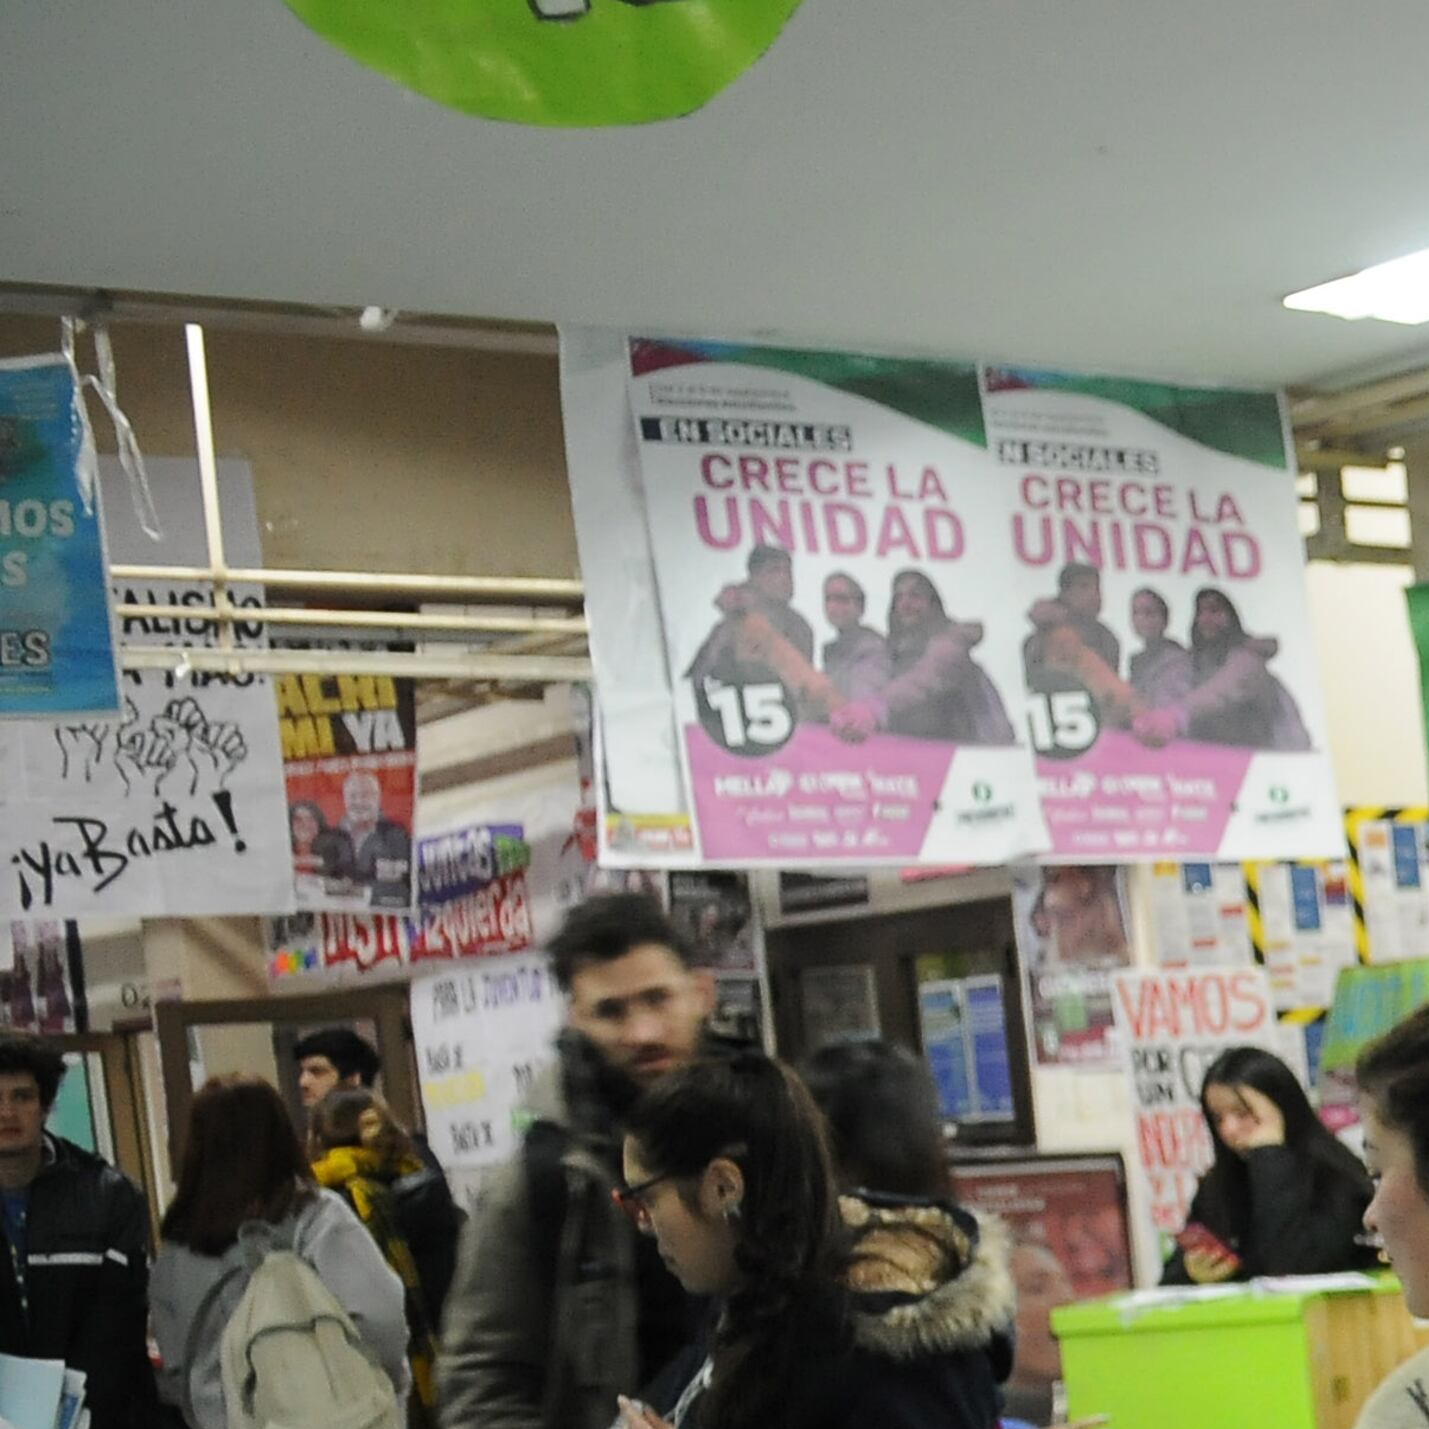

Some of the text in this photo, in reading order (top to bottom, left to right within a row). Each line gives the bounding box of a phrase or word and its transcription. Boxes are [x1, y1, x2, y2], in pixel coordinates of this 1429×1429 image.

[659, 420, 850, 450] EN SOCIALES
[1038, 444, 1159, 475] SOCIALES
[701, 453, 948, 502] CRECE LA
[1021, 474, 1245, 525] CRECE LA
[693, 495, 966, 562] UNIDAD
[1011, 513, 1262, 579] UNIDAD
[707, 683, 793, 746] 15
[1027, 691, 1094, 752] 15
[1115, 969, 1267, 1040] VAMOS
